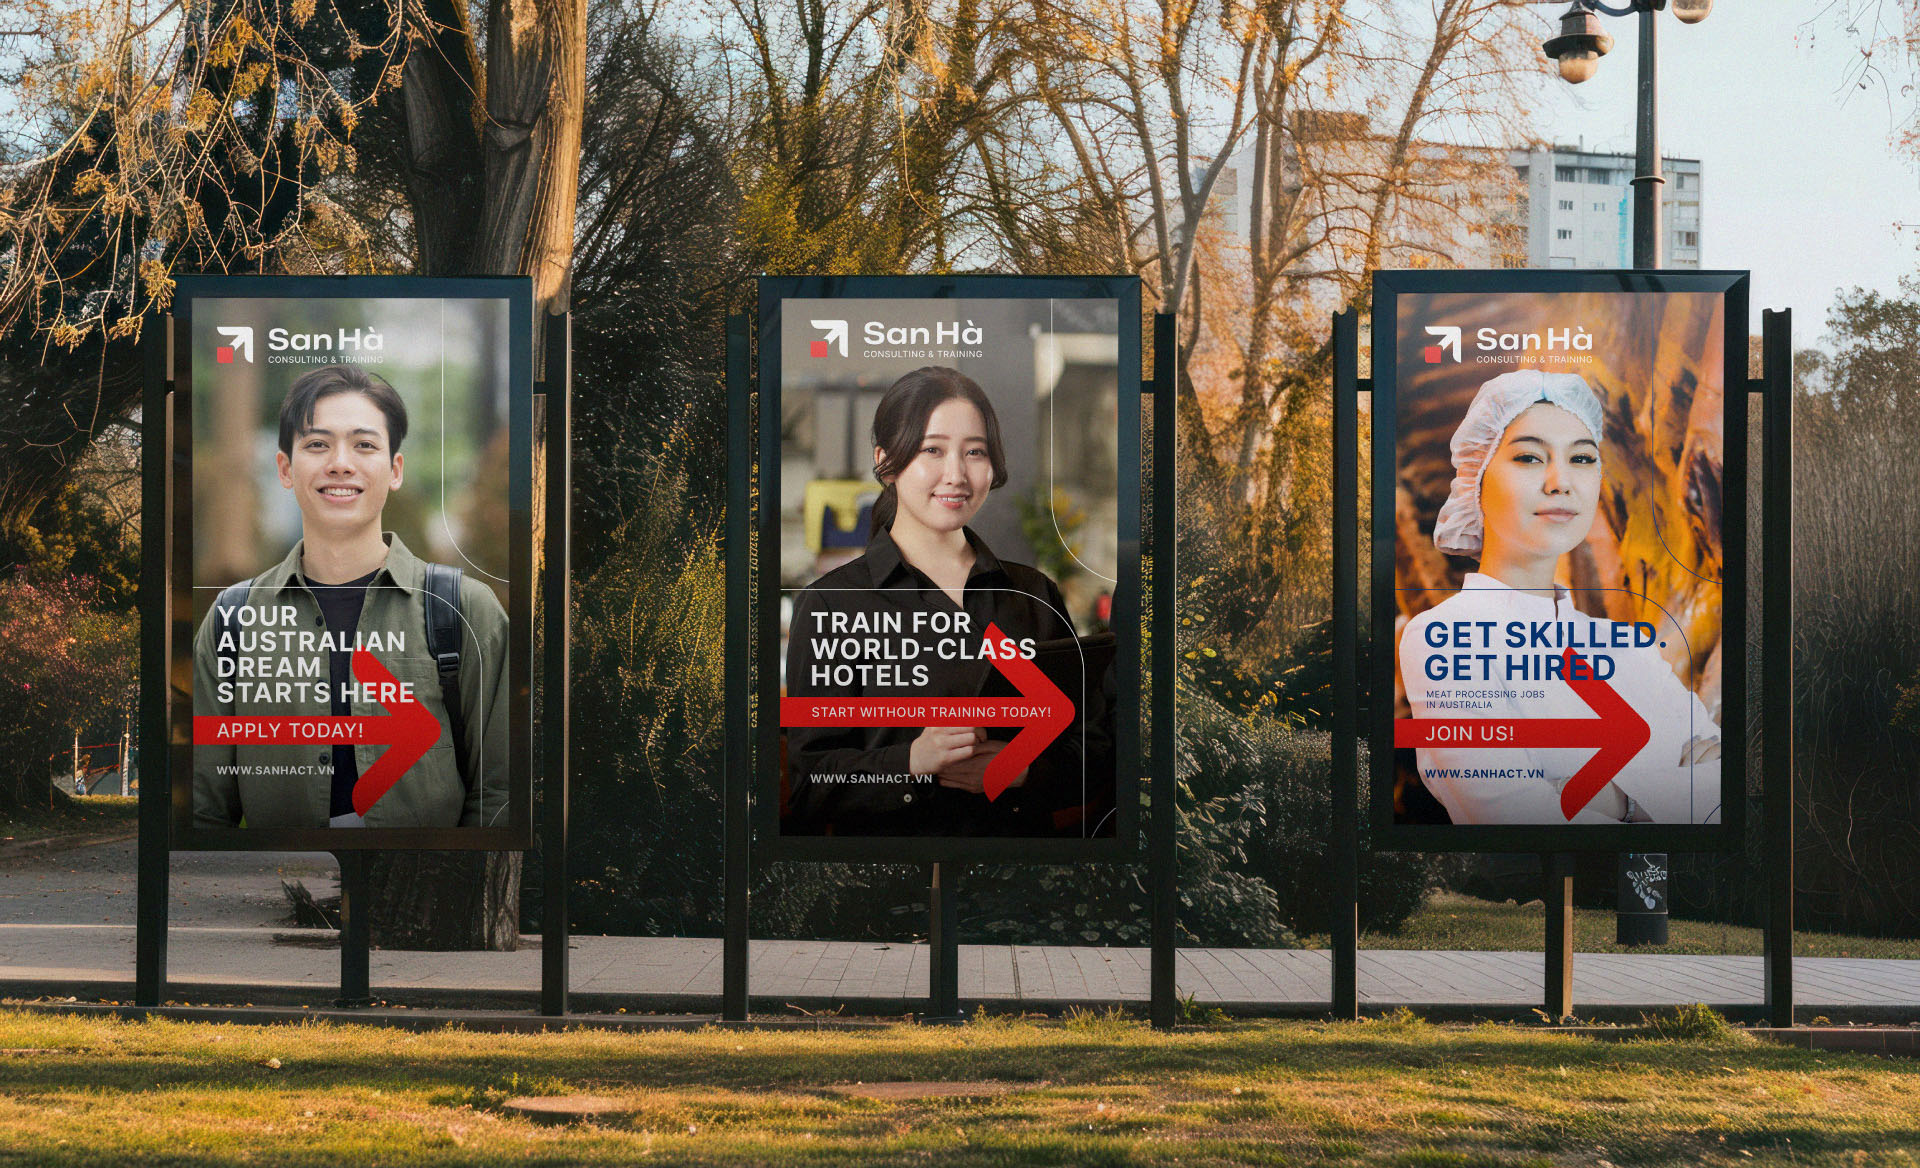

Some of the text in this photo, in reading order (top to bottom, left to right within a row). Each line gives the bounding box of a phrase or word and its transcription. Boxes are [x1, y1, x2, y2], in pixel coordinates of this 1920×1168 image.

[268, 326, 384, 351] San Hà
[863, 319, 983, 345] San Hà
[1476, 326, 1593, 351] San Hà
[268, 355, 384, 364] CONSULTING & TRAINING
[863, 350, 983, 358] CONSULTING & TRAINING
[1476, 355, 1593, 364] CONSULTING & TRAINING
[217, 605, 298, 627] YOUR
[811, 611, 971, 633] TRAIN FOR
[217, 631, 405, 652] AUSTRALIAN
[1424, 621, 1667, 649] GET SKILLED.
[811, 638, 1037, 660] WORLD-CLASS
[217, 656, 321, 678] DREAM
[811, 664, 929, 687] HOTELS
[1424, 654, 1616, 681] GET HIRED
[217, 682, 415, 703] STARTS HERE
[1426, 690, 1545, 699] MEAT PROCESSING JOBS
[811, 706, 1051, 718] START WITHOUR TRAINING TODAY!
[1426, 701, 1493, 709] IN AUSTRALIA
[217, 723, 363, 738] APPLY TODAY!
[1425, 726, 1514, 742] JOIN US!
[216, 765, 335, 775] WWW.SANHACT.VN
[810, 774, 933, 784] WWW.SANHACT.VN
[1425, 769, 1545, 779] WWW.SANHACT.VN
